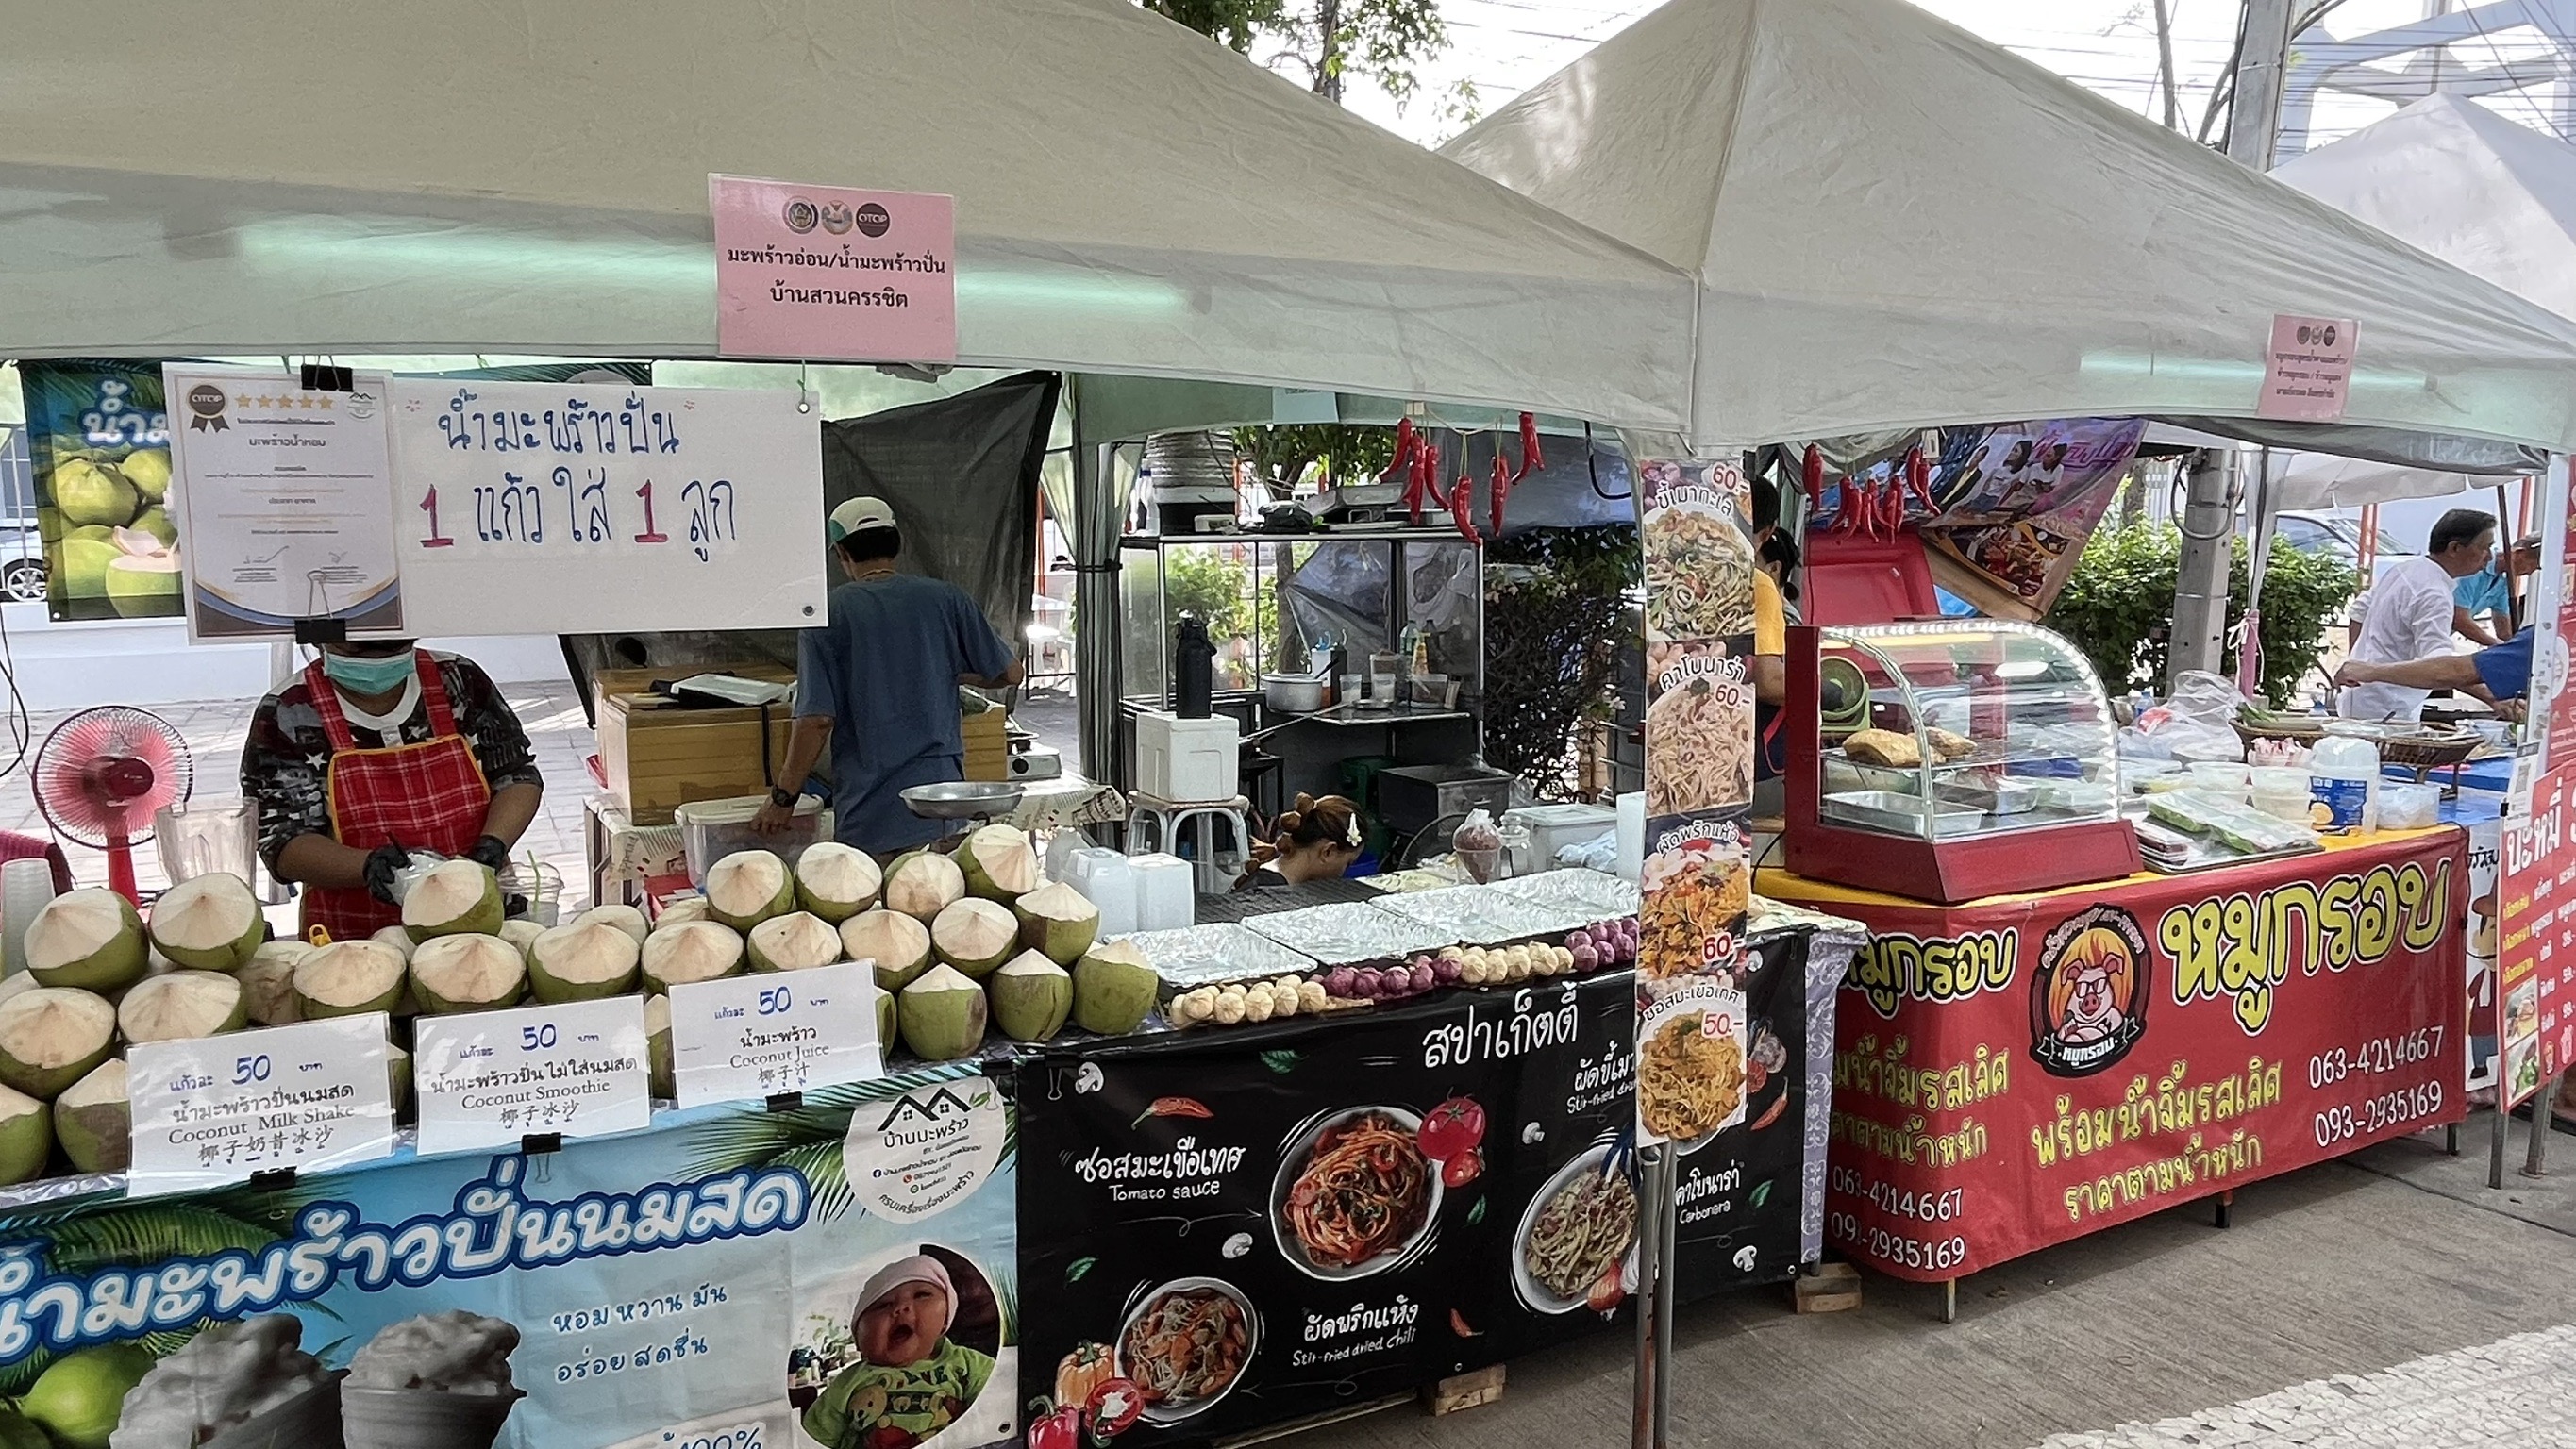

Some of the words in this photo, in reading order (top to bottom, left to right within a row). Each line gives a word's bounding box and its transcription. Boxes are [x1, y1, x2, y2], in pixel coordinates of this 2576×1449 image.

[727, 243, 945, 274] มะพร้าวอ่อน/น้ำมะพร้าวปั่น
[769, 279, 909, 308] บ้านสวนครรชิต
[249, 433, 326, 447] มะพร้าวน้ำหอม
[437, 387, 680, 454] น้ำมะพร้าวปั่น
[419, 483, 455, 548] 1
[633, 478, 669, 543] 1
[681, 479, 736, 563] ลูก
[1660, 653, 1746, 691] คาโบนาร่า
[2161, 859, 2451, 1032] หมูกรอบ
[1850, 933, 2016, 1011] มูกรอบ
[758, 986, 792, 1016] 50
[520, 1023, 557, 1052] 50
[739, 1025, 817, 1049] น้ำมะพร้าว
[1421, 981, 1579, 1069] สปาเก็ตตี้
[231, 1054, 272, 1085] 50
[729, 1051, 793, 1069] Coconut
[794, 1044, 830, 1062] Juice
[758, 1061, 811, 1083] 椰子汁
[2308, 1025, 2445, 1090] 063-4214667
[172, 1082, 355, 1124] น้ำมะพร้าวปั่นนมสด
[461, 1091, 532, 1110] Coconut
[535, 1078, 611, 1101] Smoothie
[499, 1098, 580, 1125] 椰子冰沙
[2031, 1055, 2284, 1169] พร้อมน้ำจิ้มรสเลิศ
[2314, 1080, 2444, 1147] 093-2935169
[168, 1121, 248, 1145] Coconut
[259, 1111, 299, 1131] Milk
[303, 1104, 355, 1124] Shake
[883, 1117, 970, 1148] บ้านมะพร้าว
[1074, 1135, 1247, 1183] ซอสมะเขือเทศ
[2063, 1130, 2264, 1223] ราคาตามน้ำหนัก
[1108, 1183, 1166, 1202] Tomato
[1172, 1179, 1221, 1201] sauce
[1675, 1158, 1740, 1207] คาโบนาร่า
[1831, 1211, 1966, 1271] 09-2935169
[552, 1301, 610, 1335] หอม
[617, 1291, 685, 1323] หวาน
[691, 1281, 728, 1310] มัน
[1303, 1293, 1419, 1342] ผัดพริกแห้ง
[556, 1346, 627, 1384] อร่อย
[633, 1326, 710, 1370] สดชื่น
[1292, 1345, 1350, 1367] Stir-fried
[1351, 1336, 1384, 1357] dried
